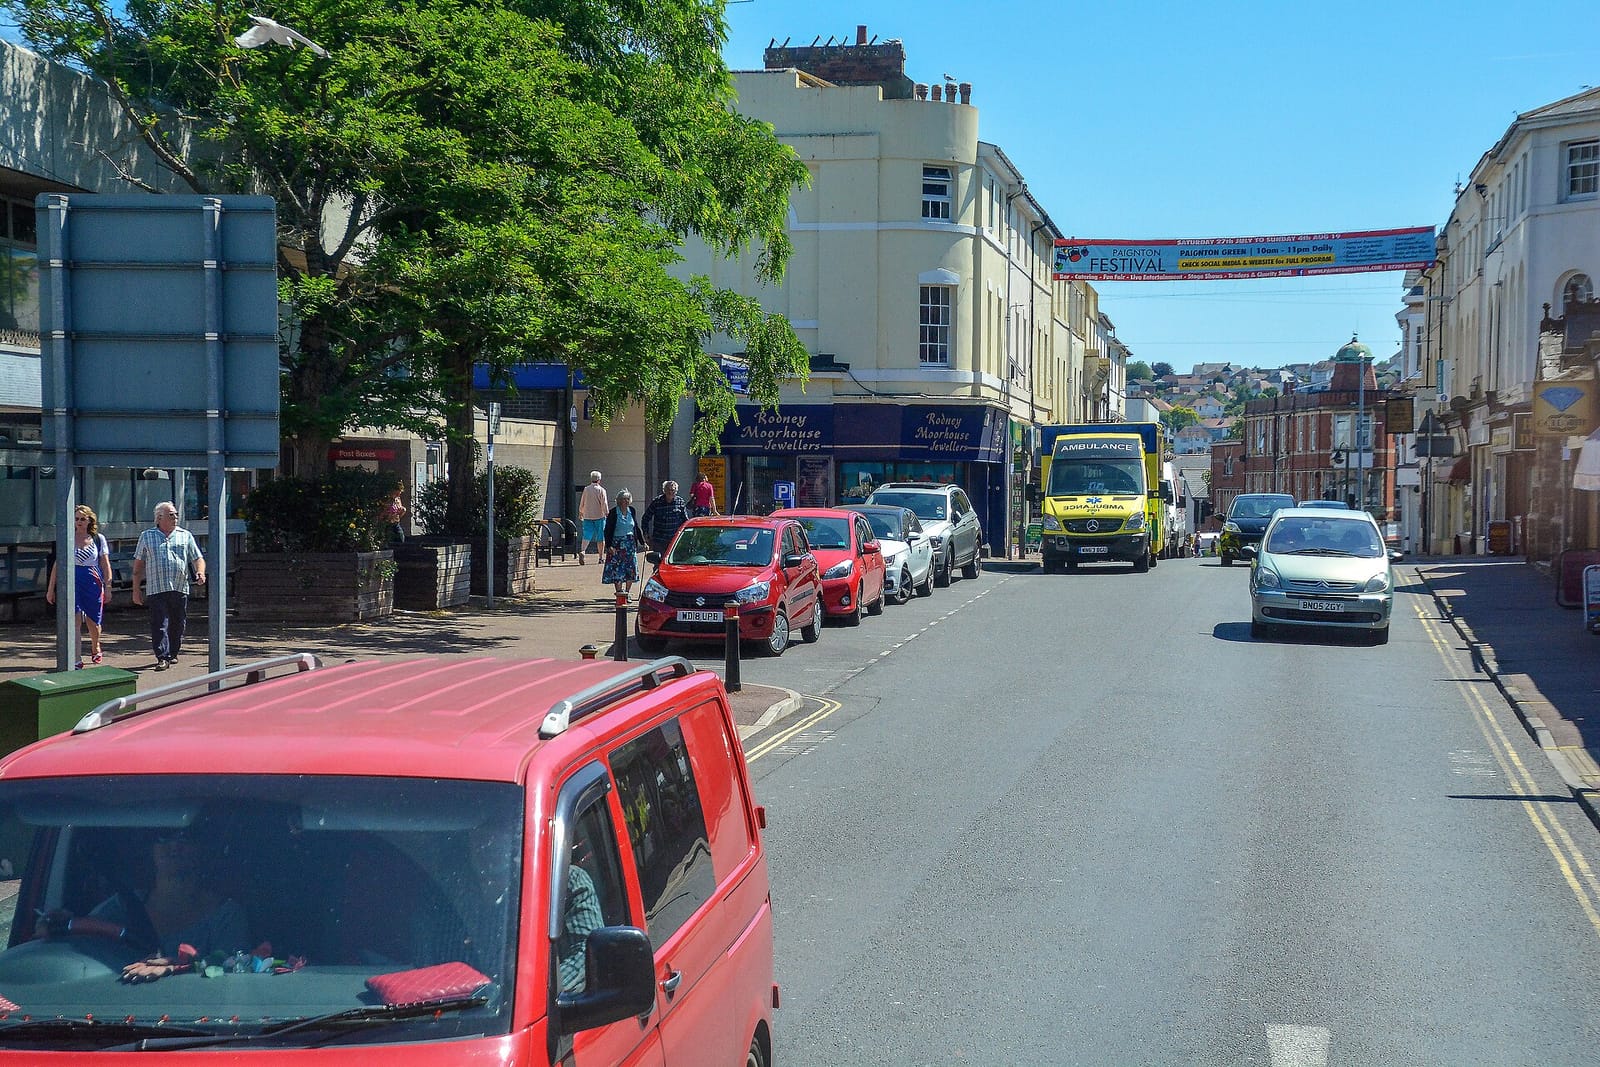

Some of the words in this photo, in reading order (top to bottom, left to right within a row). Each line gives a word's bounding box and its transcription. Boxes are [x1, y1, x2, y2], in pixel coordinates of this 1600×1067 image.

[1112, 248, 1161, 257] PAIGNTON
[1288, 246, 1310, 254] 11pm
[1312, 244, 1333, 252] Daily
[1090, 258, 1166, 272] FESTIVAL
[754, 412, 807, 427] Rodney
[926, 412, 962, 429] Rodney
[741, 426, 821, 438] Moorhouse
[915, 427, 970, 440] Moorhouse
[764, 439, 820, 450] Jewellers
[930, 441, 968, 451] Jewellers
[1060, 443, 1133, 452] AMBULANCE
[778, 486, 789, 498] P
[1302, 602, 1324, 610] BN05
[682, 612, 700, 620] WD18
[702, 612, 718, 621] UPB
